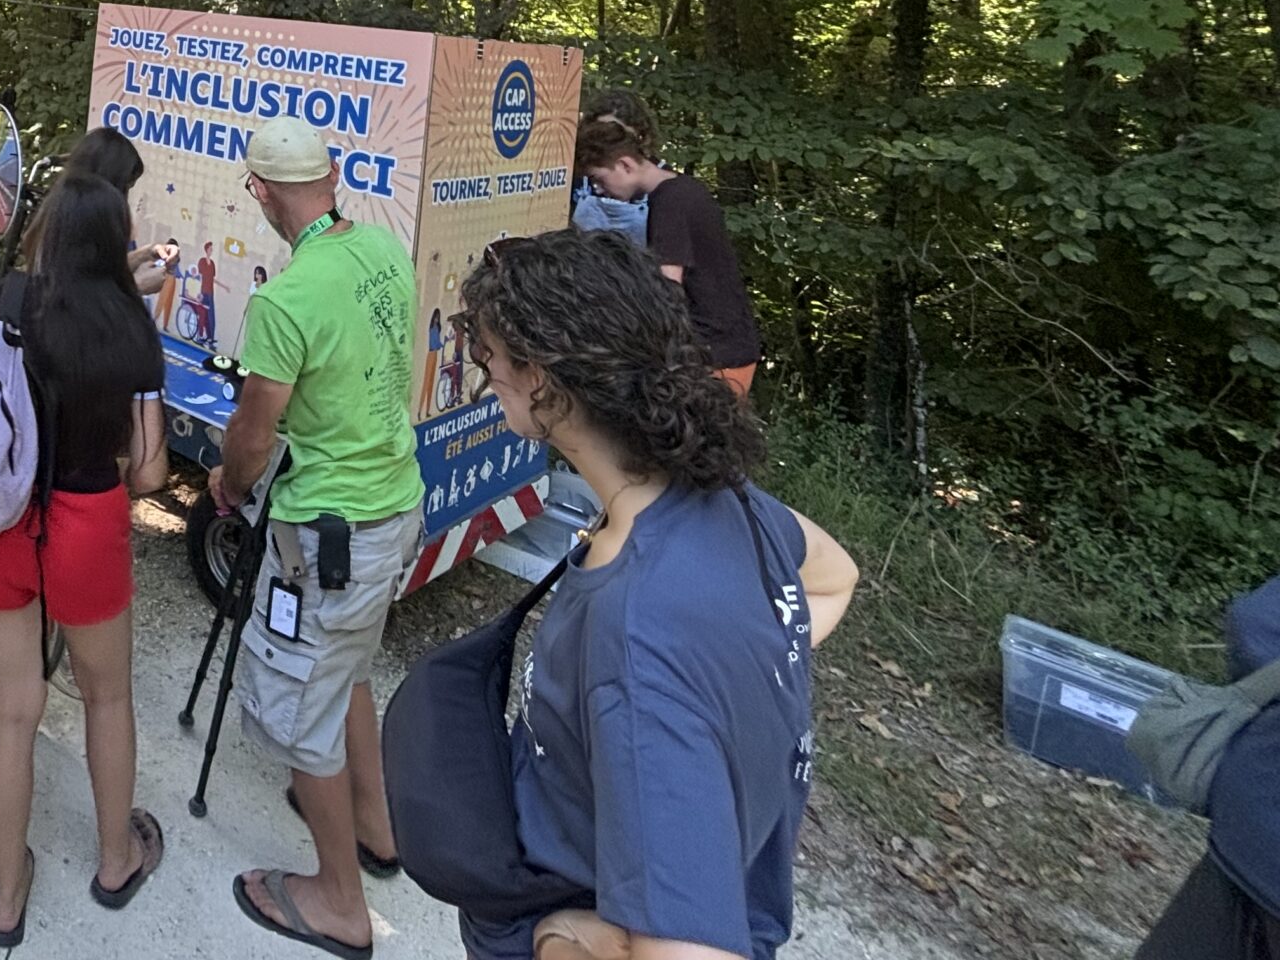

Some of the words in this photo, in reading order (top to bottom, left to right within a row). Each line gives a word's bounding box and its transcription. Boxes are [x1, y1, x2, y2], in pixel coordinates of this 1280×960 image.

[110, 28, 170, 56] JOUEZ,
[176, 36, 249, 68] TESTEZ,
[257, 46, 405, 85] COMPRENEZ
[125, 61, 370, 135] L'INCLUSION
[505, 88, 526, 107] CAP
[103, 102, 256, 161] COMMEN
[494, 112, 532, 131] ACCESS
[432, 177, 493, 203] TOURNEZ,
[497, 172, 535, 194] TESTEZ,
[538, 168, 567, 189] JOUEZ
[424, 404, 488, 447] L'INCLUSION
[445, 434, 463, 460] ÉTÉ
[465, 424, 494, 451] AUSSI
